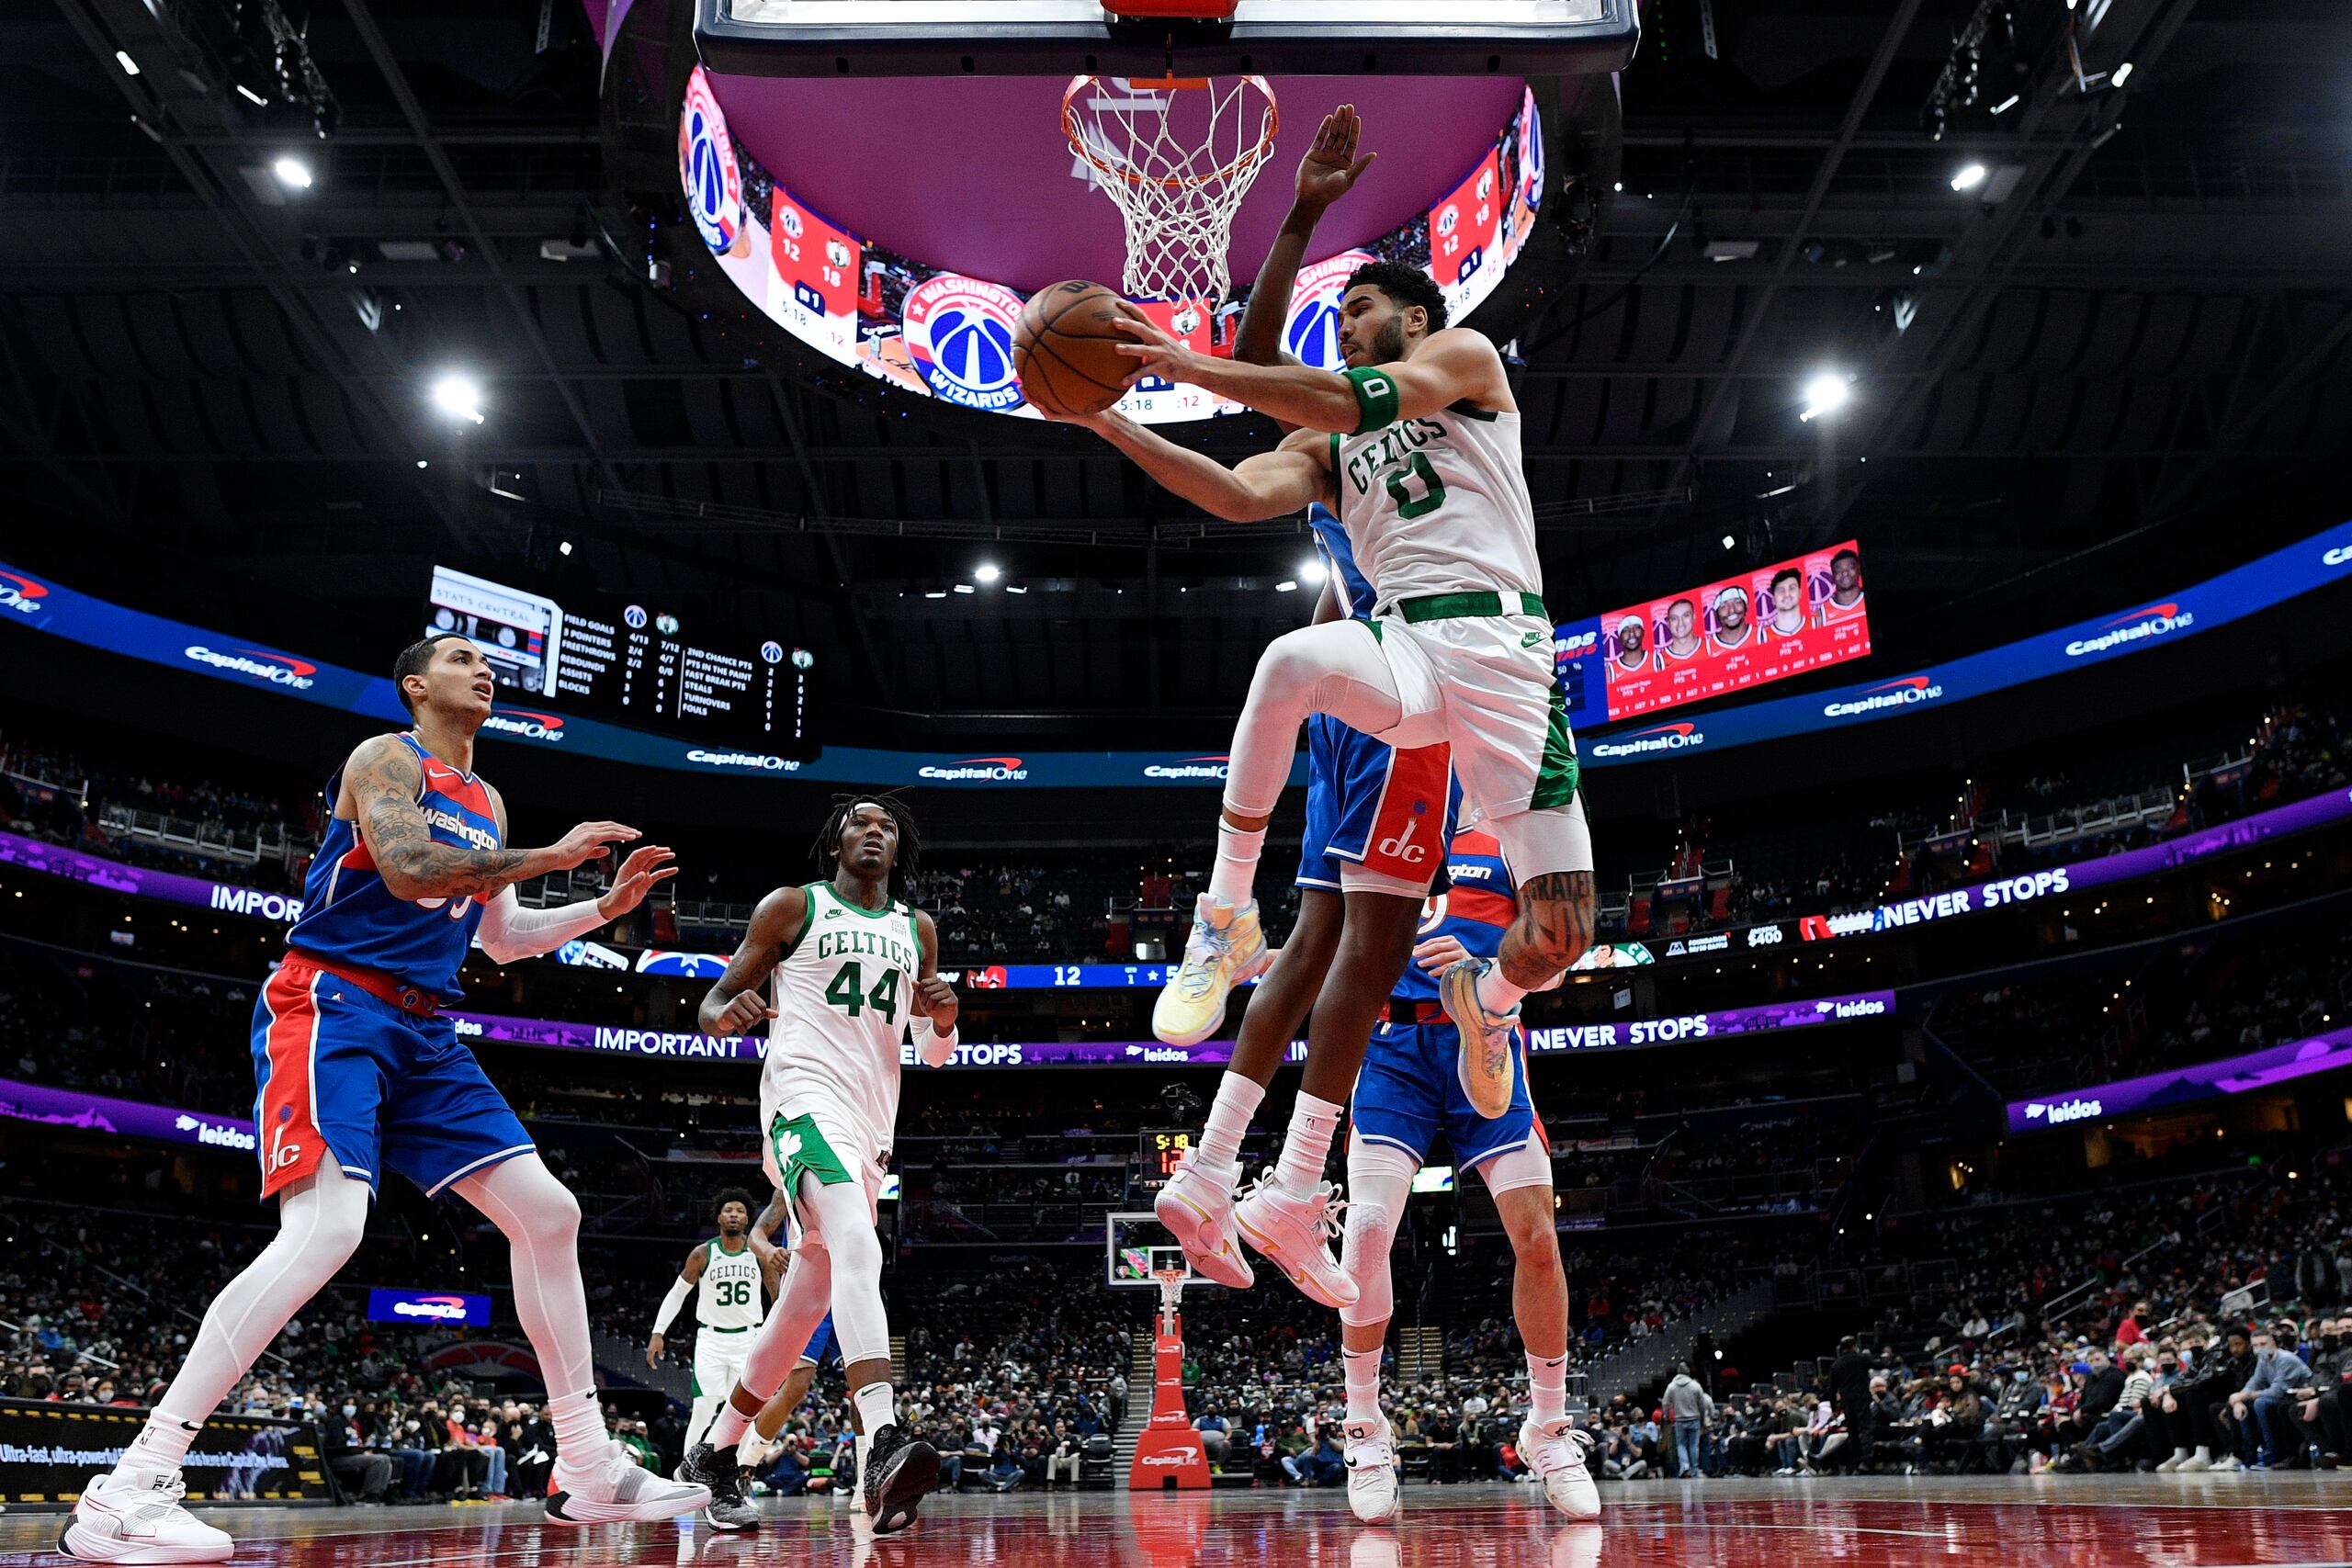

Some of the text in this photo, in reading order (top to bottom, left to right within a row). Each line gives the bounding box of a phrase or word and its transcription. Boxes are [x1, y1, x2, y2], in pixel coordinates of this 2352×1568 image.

[783, 238, 800, 262] 12
[929, 368, 1019, 407] WIZARDS
[1121, 400, 1152, 411] 5:18
[1386, 451, 1446, 520] 0
[564, 614, 587, 626] FIELD
[587, 620, 615, 635] GOALS
[561, 639, 616, 661] FREETHROWS
[571, 629, 612, 648] POINTERS
[560, 653, 605, 672] REBOUNDS
[685, 659, 701, 670] PTS
[702, 662, 711, 671] IN
[712, 665, 728, 676] THE
[729, 670, 752, 682] PAINT
[687, 648, 705, 659] 2ND
[706, 652, 737, 667] CHANCE
[738, 660, 752, 671] PTS
[560, 667, 593, 682] ASSISTS
[685, 670, 705, 681] FAST
[705, 674, 730, 687] BREAK
[731, 681, 746, 691] PTS
[558, 679, 590, 694] BLOCKS
[684, 681, 712, 694] STEALS
[684, 692, 730, 710] TURNOVERS
[683, 703, 707, 716] FOULS
[764, 723, 771, 731] 0
[420, 807, 498, 851] Washington
[210, 886, 304, 923] IMPOR
[1883, 891, 1971, 929] NEVER
[1983, 868, 2069, 908] STOPS
[1747, 931, 1782, 948] $400
[819, 931, 911, 974] CELTICS
[1055, 966, 1081, 986] 12
[1128, 975, 1134, 985] 1
[825, 961, 899, 1025] 44
[1836, 998, 1884, 1018] leidos
[594, 1027, 742, 1059] IMPORTANT
[1531, 1014, 1708, 1051] NEVER STOPS
[945, 1043, 1023, 1066] STOPS
[1144, 1048, 1189, 1063] leidos
[2047, 1099, 2102, 1124] leidos
[198, 1122, 255, 1150] leidos
[1156, 1134, 1189, 1150] 5:18
[1161, 1149, 1184, 1175] 12
[709, 1265, 756, 1281] CELTICS
[716, 1280, 751, 1306] 36
